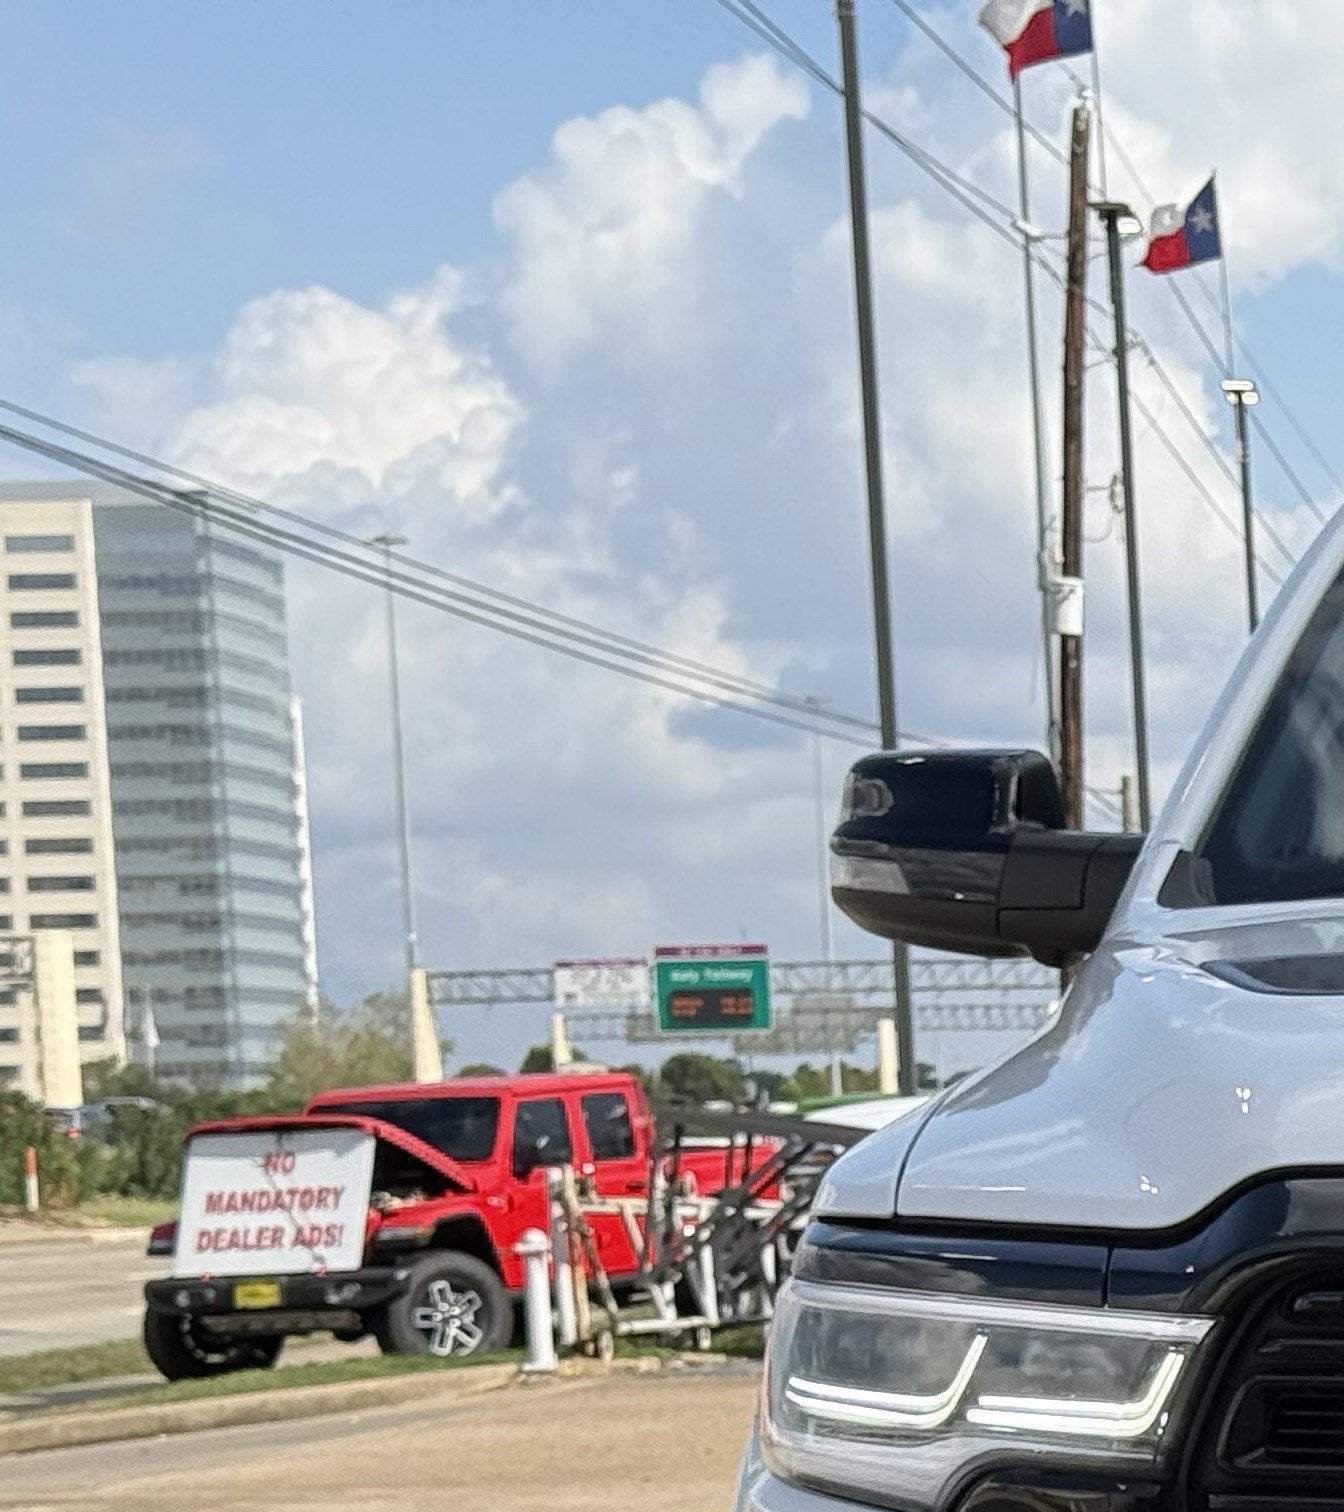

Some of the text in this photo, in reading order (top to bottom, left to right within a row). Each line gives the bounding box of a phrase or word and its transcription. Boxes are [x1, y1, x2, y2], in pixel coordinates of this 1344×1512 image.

[264, 1152, 296, 1174] NO
[205, 1186, 345, 1214] MANDATORY
[196, 1226, 285, 1254] DEALER
